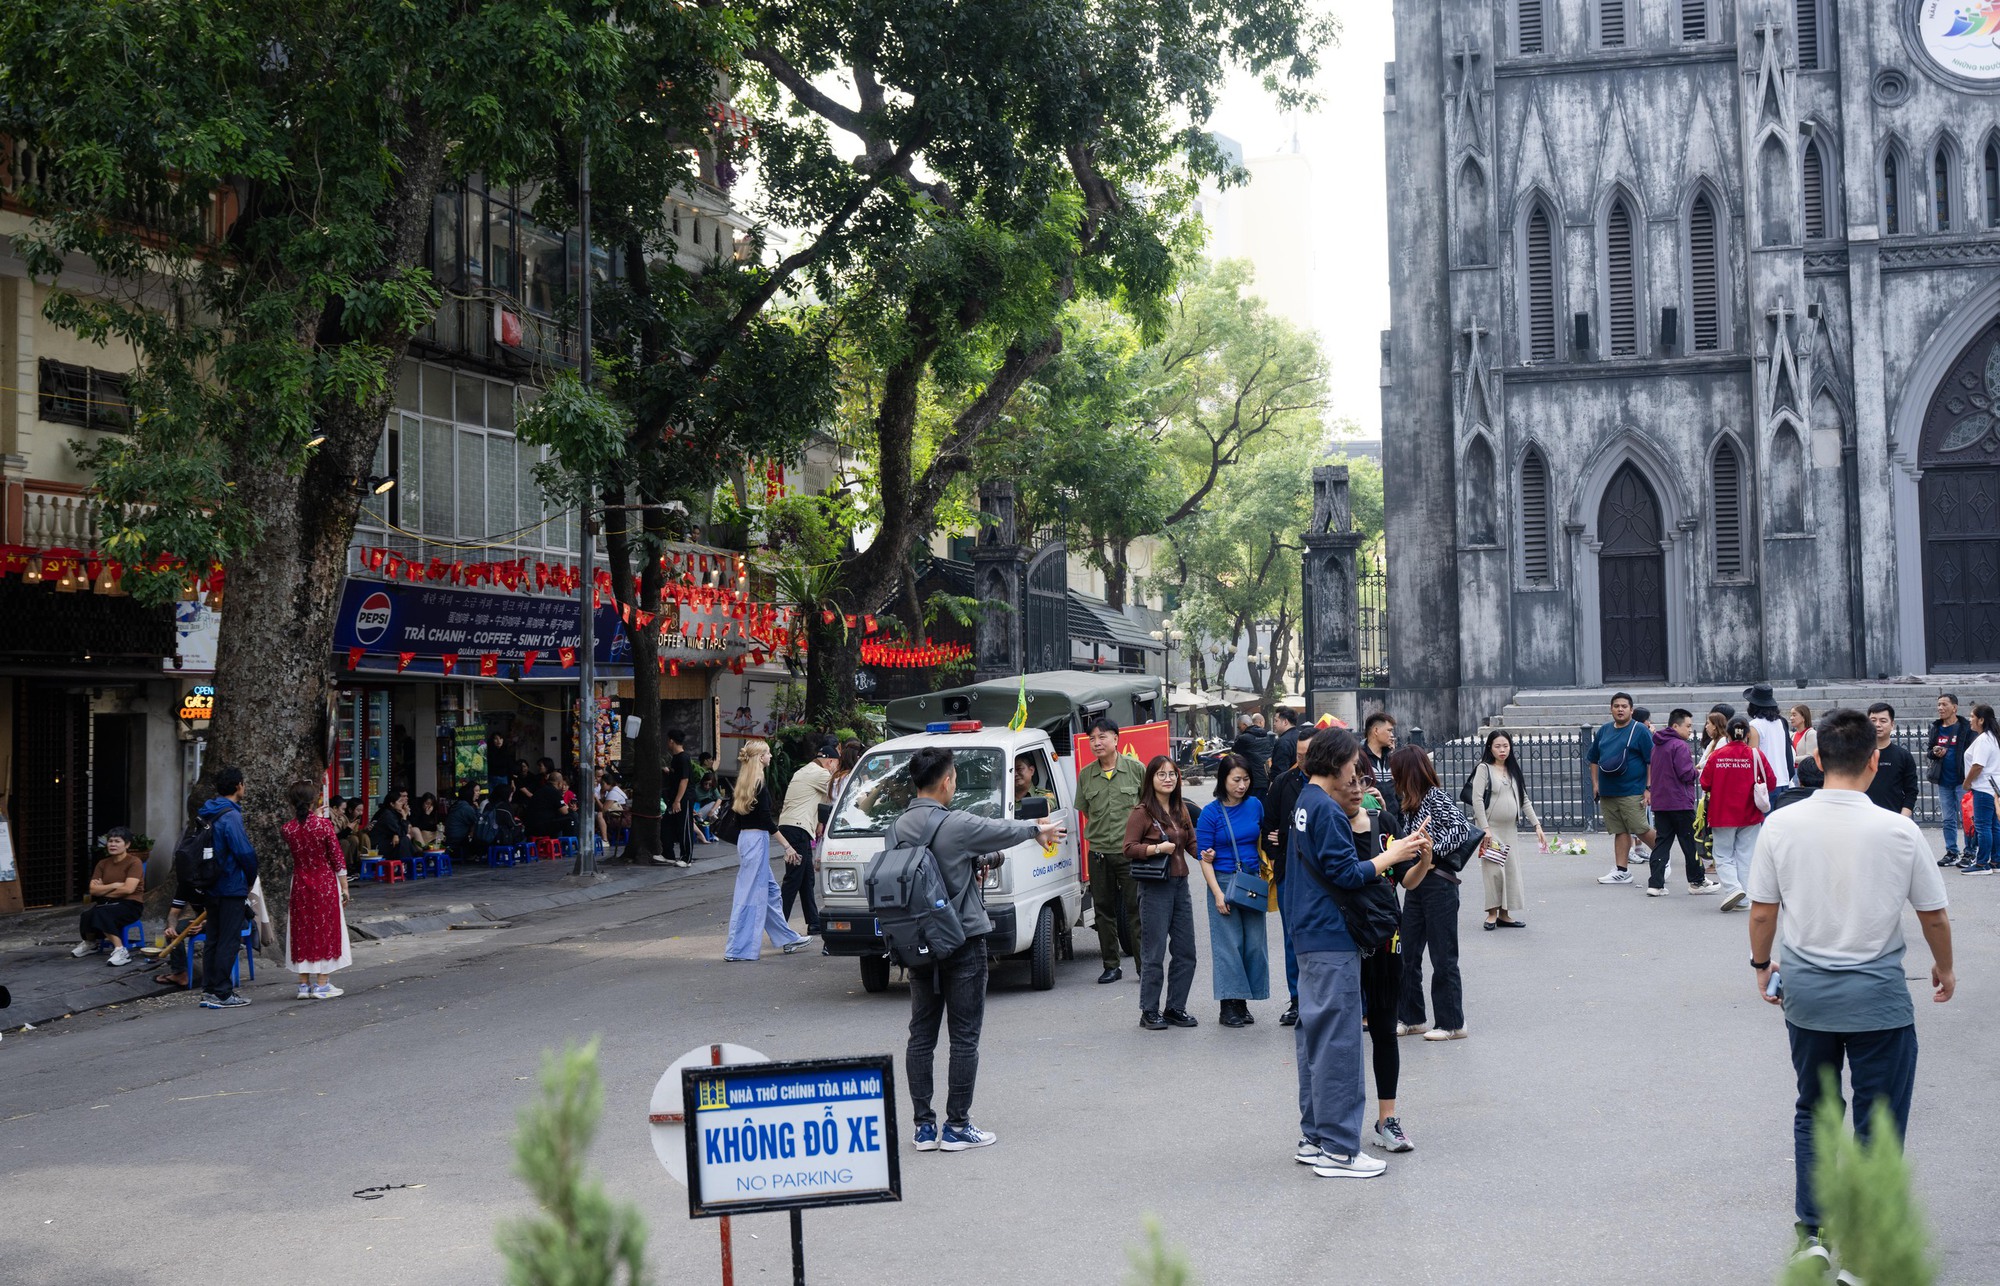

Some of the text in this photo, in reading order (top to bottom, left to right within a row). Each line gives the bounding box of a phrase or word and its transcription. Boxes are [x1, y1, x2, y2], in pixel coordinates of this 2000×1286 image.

[1952, 58, 2000, 71] NHỮNG NGƯỜ
[358, 612, 389, 624] PEPSI
[428, 628, 466, 642] CHANH
[473, 631, 512, 644] COFFEE
[518, 633, 543, 646] SINH
[543, 631, 557, 646] TỐ
[561, 634, 581, 648] NƯỚ
[658, 633, 682, 648] OFFEE
[704, 637, 727, 650] TAPAS
[194, 686, 214, 695] OPEN
[206, 696, 214, 708] 2
[180, 708, 212, 719] COFFEE
[1032, 866, 1047, 878] CÔNG
[1047, 864, 1054, 874] AN
[730, 1078, 880, 1104] NHÀ THỜ CHÍNH TÒA HÀ NỘI
[705, 1105, 880, 1165] KHÔNG ĐỖ XE
[737, 1168, 853, 1192] NO PARKING
